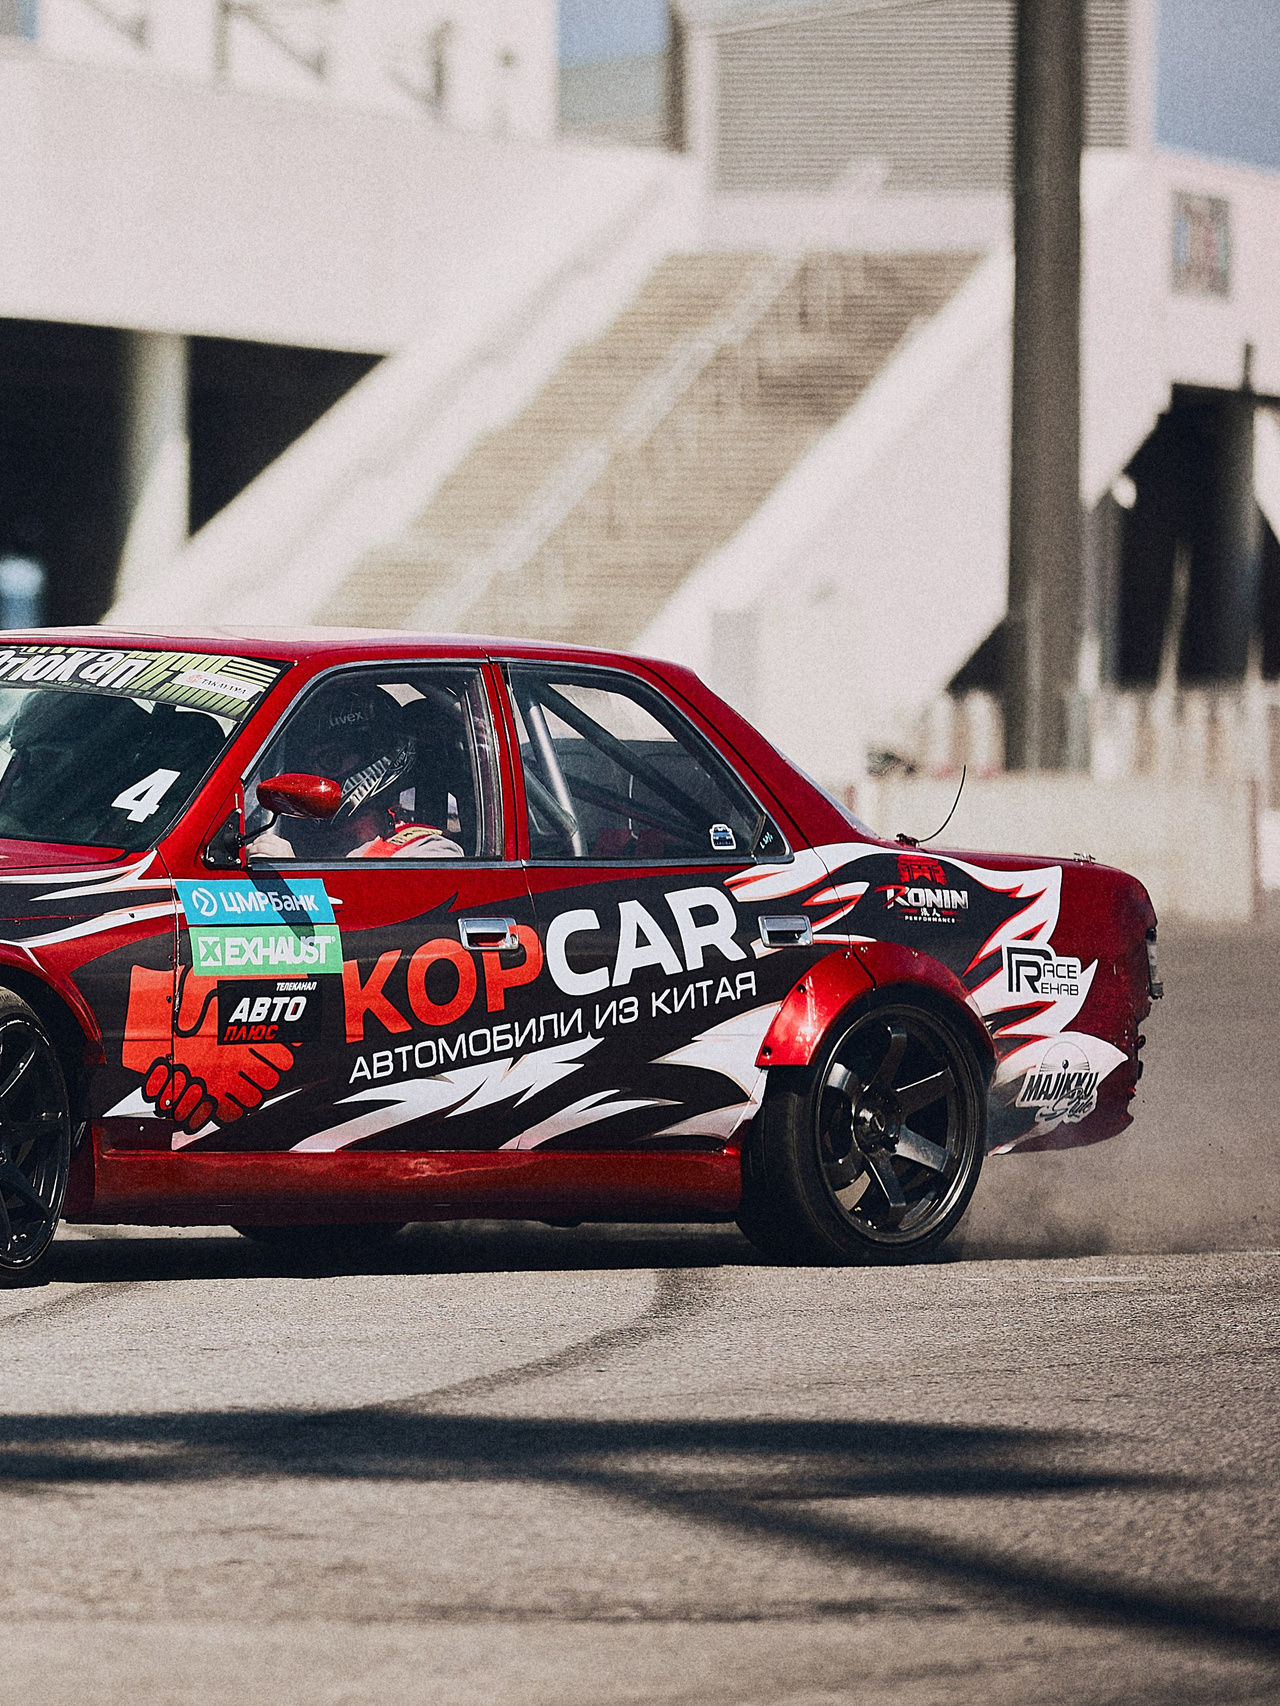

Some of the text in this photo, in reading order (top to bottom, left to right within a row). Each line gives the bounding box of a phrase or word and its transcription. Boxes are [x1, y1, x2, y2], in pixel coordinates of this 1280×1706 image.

[329, 711, 363, 727] uvex
[111, 768, 181, 823] 4
[219, 891, 319, 914] ЦМРБанк
[873, 884, 969, 910] RONIN
[224, 935, 336, 965] EXHAUST
[276, 981, 317, 991] ТЕЛЕКАНАЛ
[228, 996, 307, 1023] АВТО
[223, 1024, 279, 1042] ПЛЮС
[348, 970, 757, 1084] АВТОМОБИЛИ ИЗ КИТАЯ
